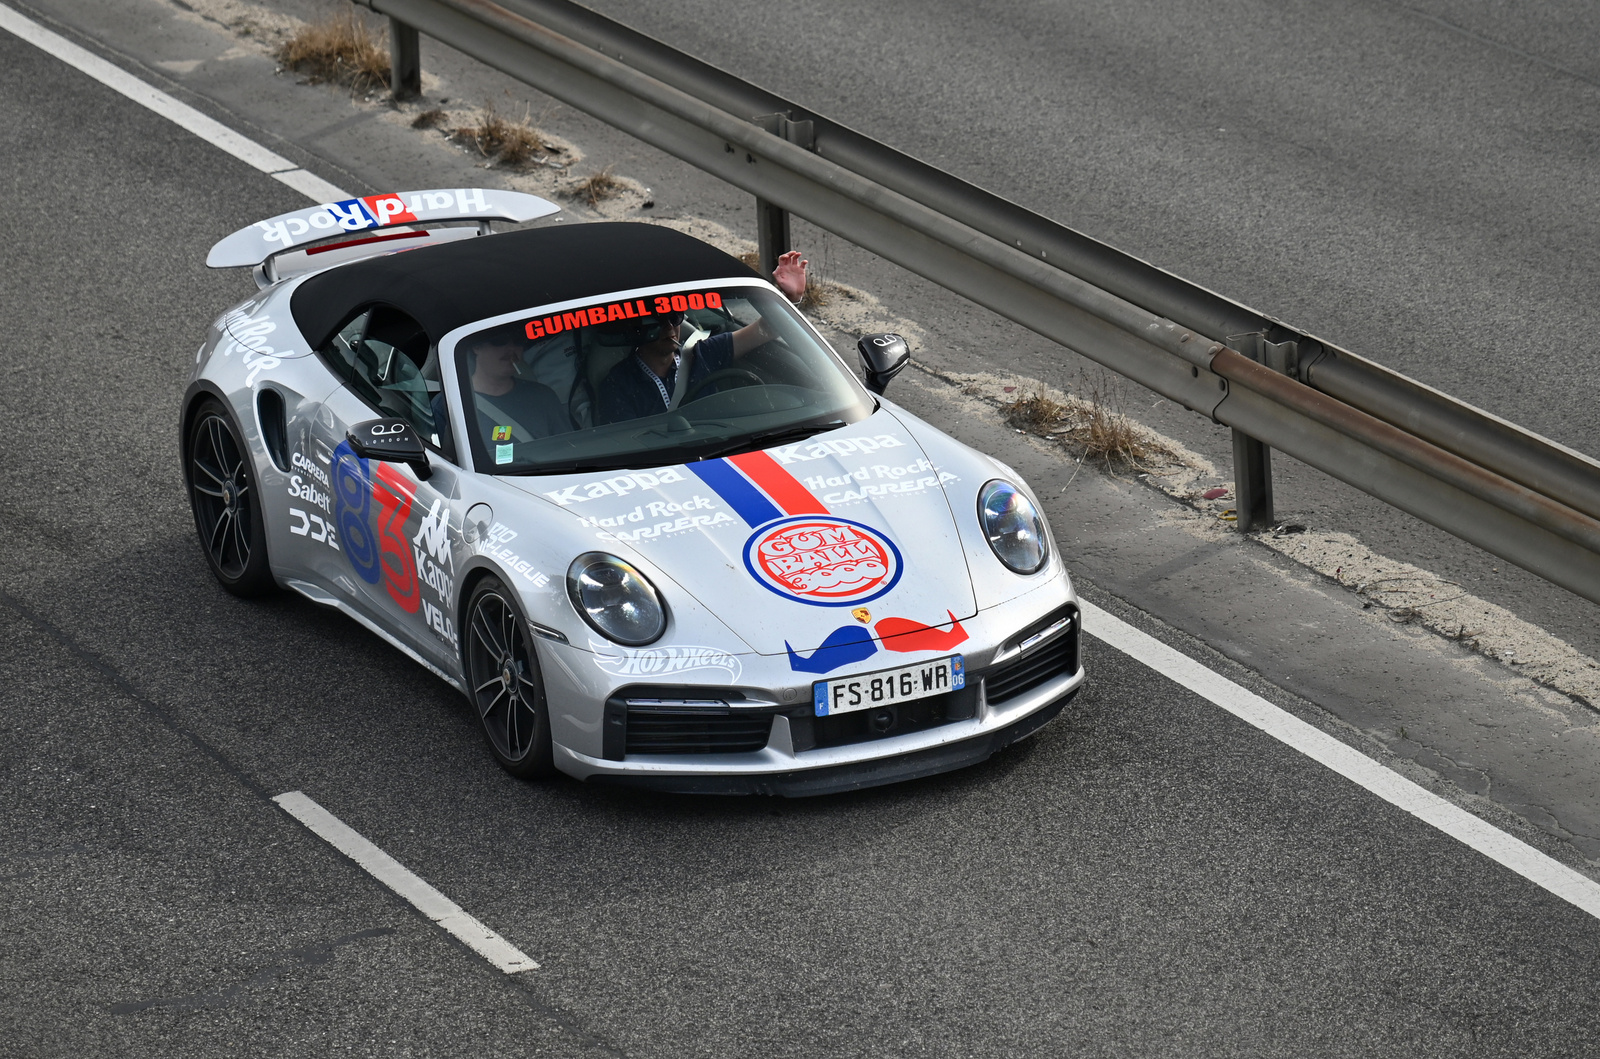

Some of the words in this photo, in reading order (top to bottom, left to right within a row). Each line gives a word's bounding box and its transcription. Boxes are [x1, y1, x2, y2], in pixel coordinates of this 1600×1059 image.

[375, 188, 493, 227] Hard
[253, 203, 374, 247] Rock
[525, 299, 652, 340] GUMBALL
[653, 292, 722, 314] 3000
[365, 437, 409, 446] LONDON
[768, 434, 907, 465] Kappa
[292, 452, 330, 489] CARRERA
[543, 467, 687, 507] Kappa
[804, 466, 871, 490] Hard
[871, 458, 939, 480] Rock
[288, 475, 332, 515] Sabelt
[823, 472, 958, 504] CARRERA
[331, 440, 420, 614] 83
[576, 506, 645, 529] Hard
[645, 495, 716, 518] Rock
[595, 511, 734, 542] CARRERA
[758, 525, 863, 557] GUM
[766, 538, 881, 578] BALL
[952, 673, 965, 687] 06
[819, 702, 825, 710] F
